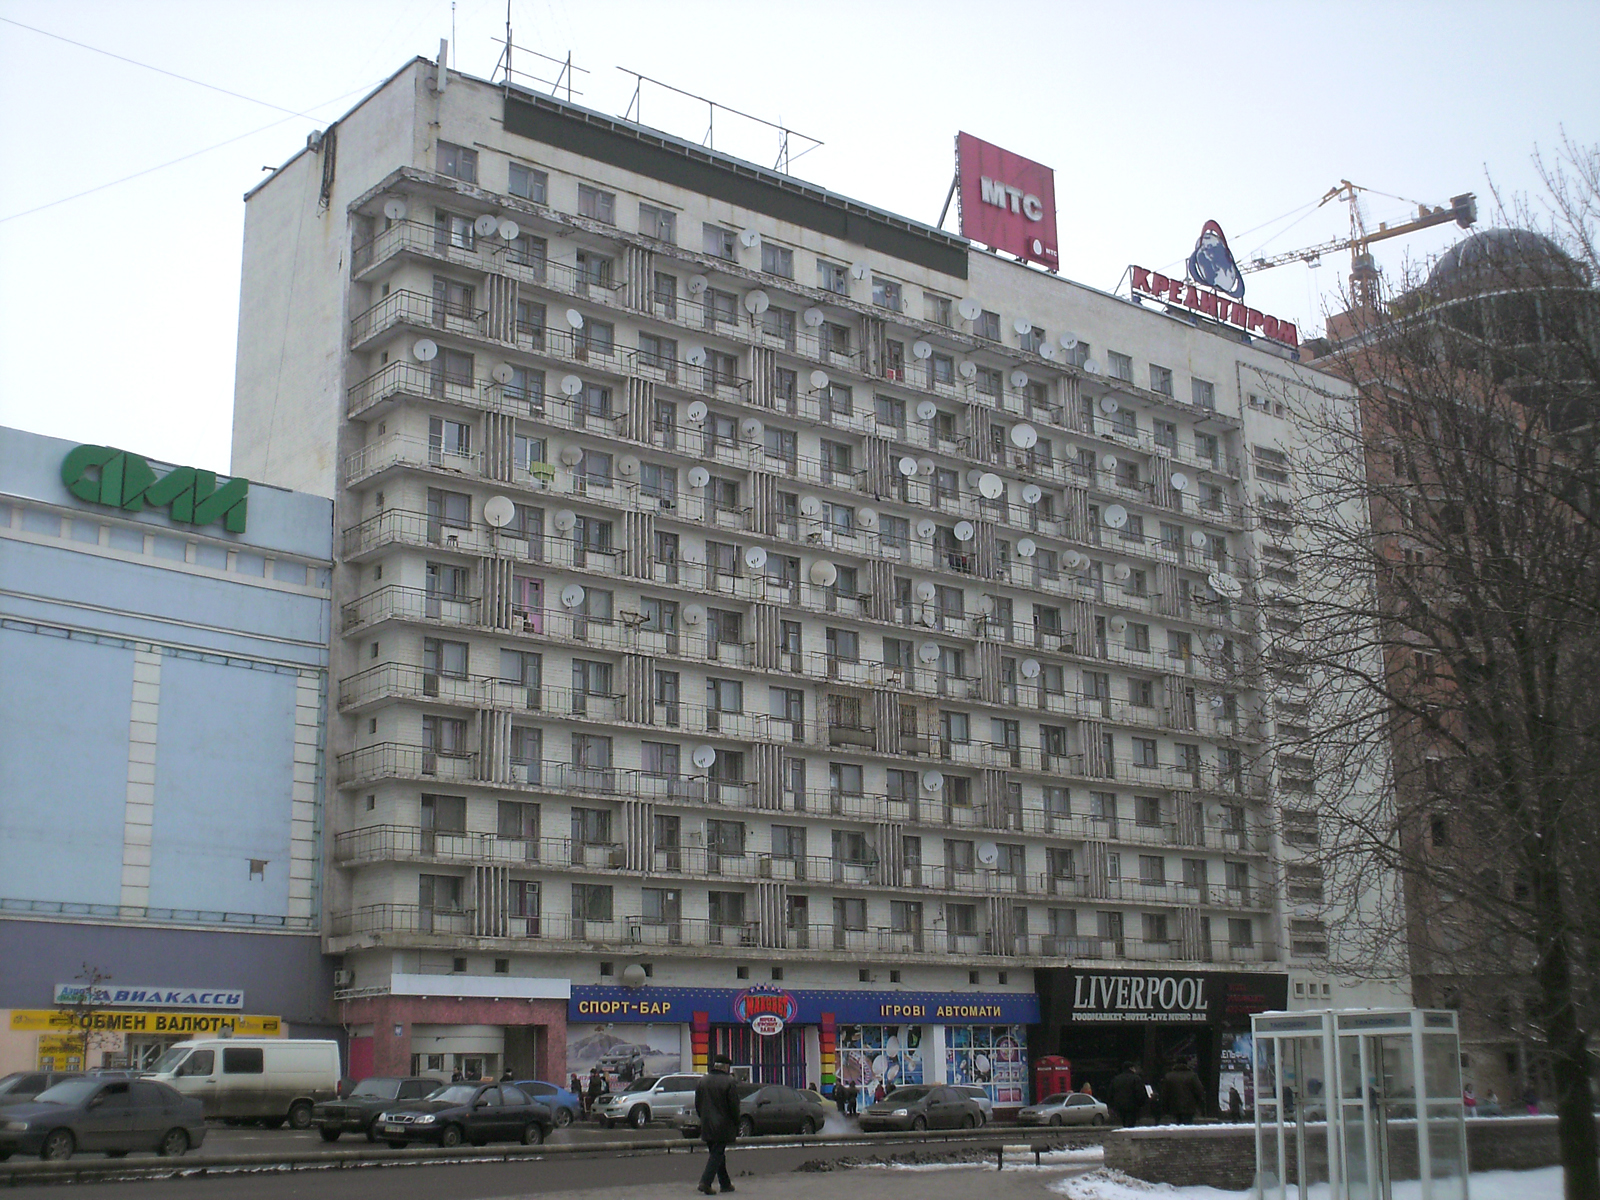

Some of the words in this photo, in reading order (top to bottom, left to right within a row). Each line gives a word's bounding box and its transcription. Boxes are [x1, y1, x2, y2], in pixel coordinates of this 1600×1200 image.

[980, 176, 1043, 222] МТС
[1132, 265, 1298, 348] КРЕДИТПРОМ
[95, 990, 241, 1005] АВИАКАССЫ
[1073, 975, 1208, 1010] LIVERPOOL
[579, 1001, 671, 1014] СПОРТ-БАР
[881, 1005, 925, 1016] ІГРОВІ
[936, 1005, 1001, 1017] АВТОМАТИ
[80, 1014, 146, 1029] ОБМЕН
[155, 1016, 235, 1032] ВАЛЮТЫ
[1168, 1013, 1191, 1021] MUSIC
[1192, 1013, 1207, 1021] BAR
